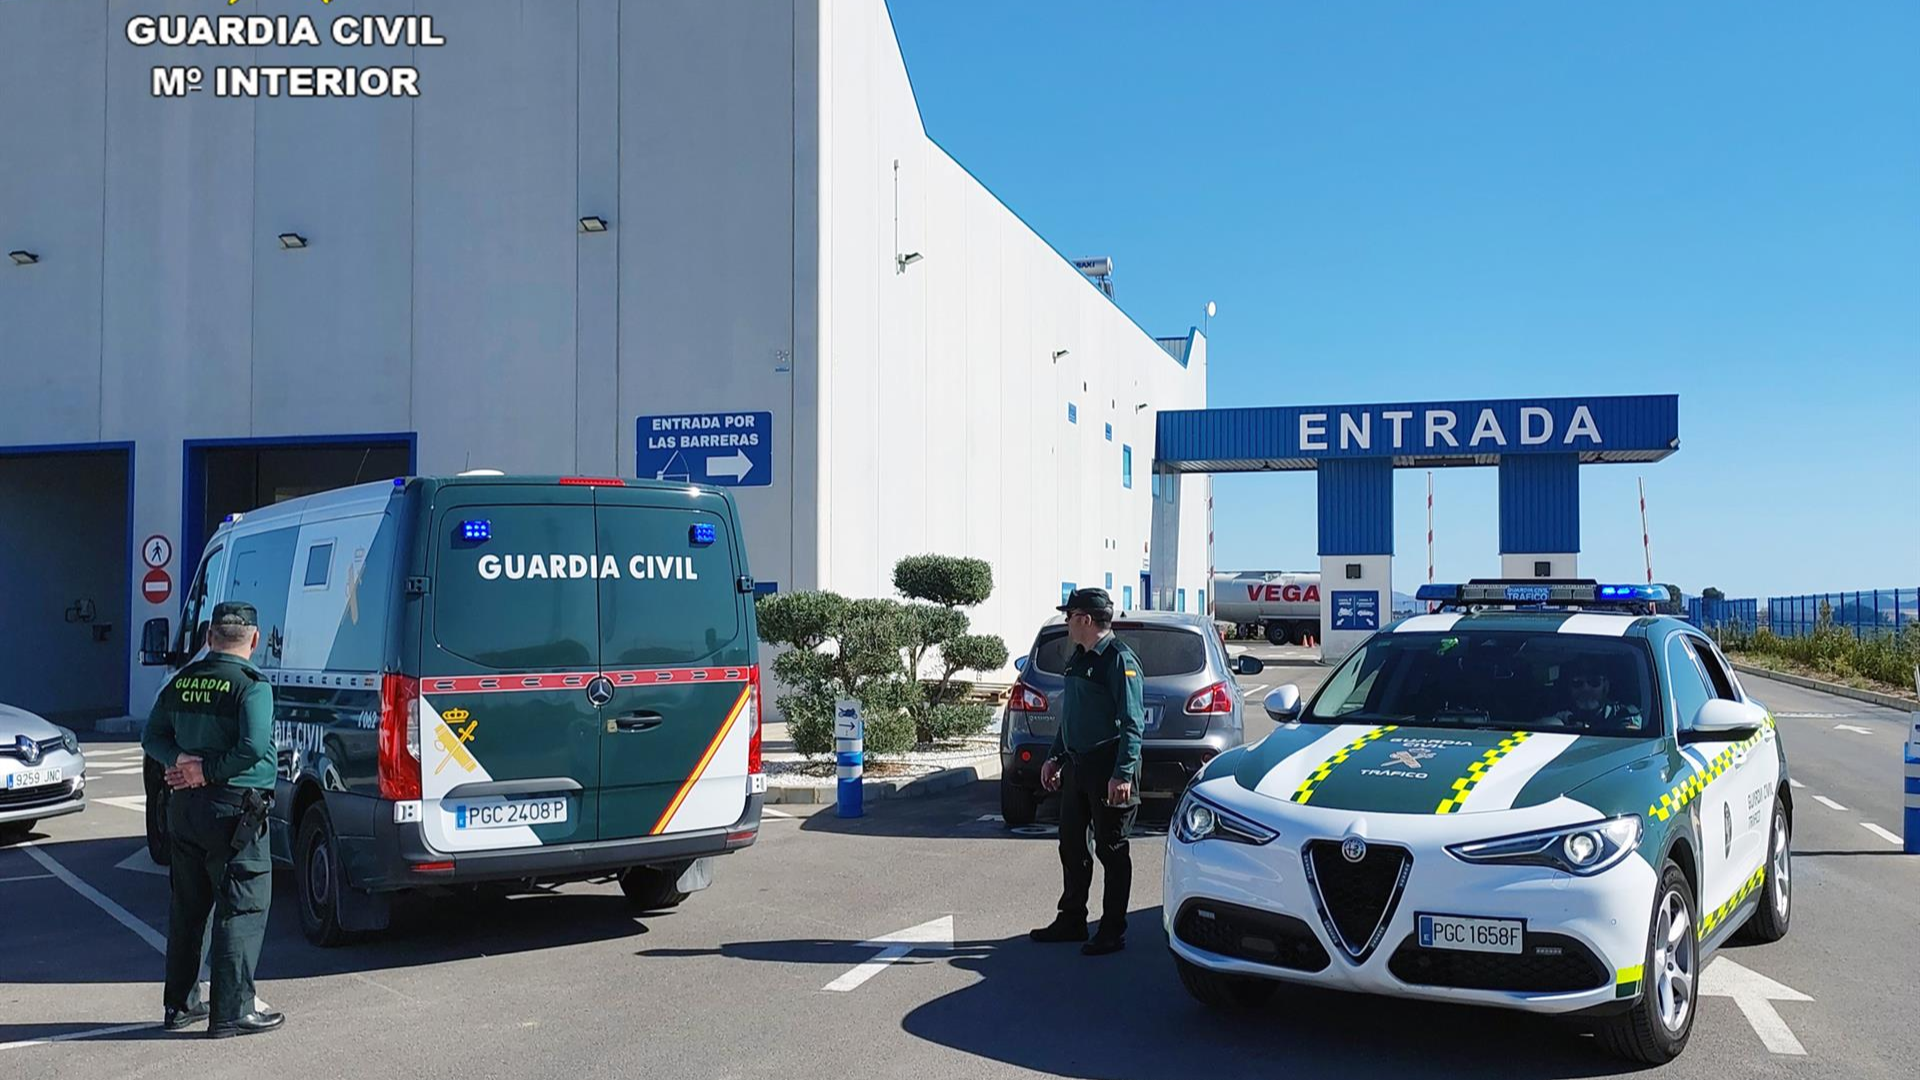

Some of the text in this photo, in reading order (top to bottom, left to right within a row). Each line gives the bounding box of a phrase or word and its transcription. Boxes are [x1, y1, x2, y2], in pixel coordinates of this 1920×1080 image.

[652, 415, 755, 431] ENTRADA POR
[1299, 405, 1603, 451] ENTRADA
[649, 433, 758, 449] LAS BARRERAS
[478, 554, 698, 580] GUARDIA CIVIL
[1247, 584, 1320, 602] VEGA
[175, 677, 231, 693] GUARDIA
[181, 690, 211, 703] CIVIL
[296, 722, 326, 753] CIVIL
[1390, 737, 1473, 747] GUARDIA
[16, 769, 60, 786] 9259 JNC
[469, 805, 503, 825] PGC
[1434, 922, 1466, 943] PGC
[1469, 925, 1521, 946] 1658F
